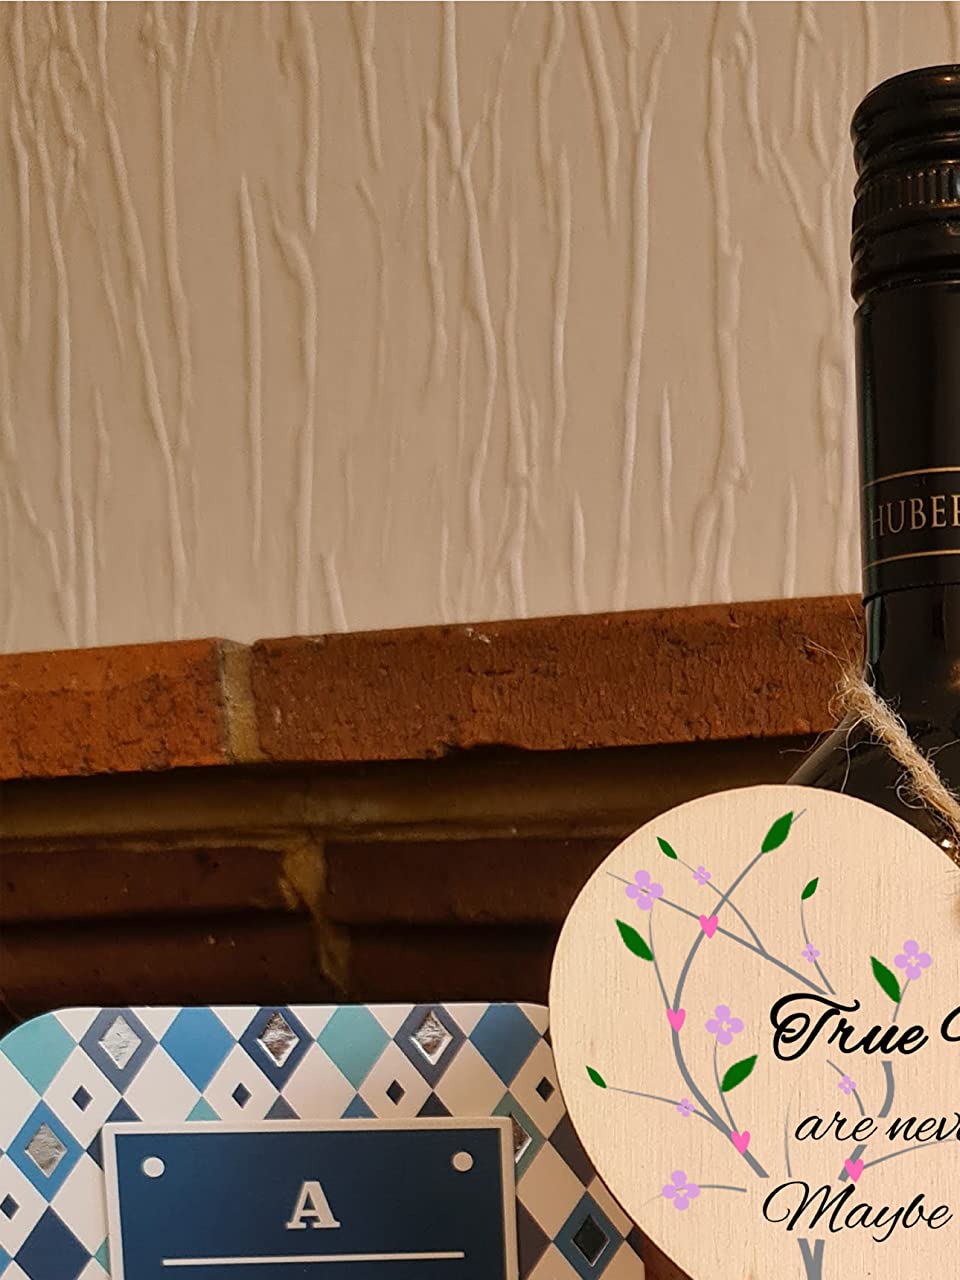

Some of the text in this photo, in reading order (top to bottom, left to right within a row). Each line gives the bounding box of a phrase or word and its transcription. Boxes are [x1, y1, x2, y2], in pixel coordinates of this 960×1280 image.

[770, 992, 930, 1061] True
[794, 1111, 880, 1143] are
[285, 1180, 341, 1230] A
[762, 1180, 953, 1243] Maybe
